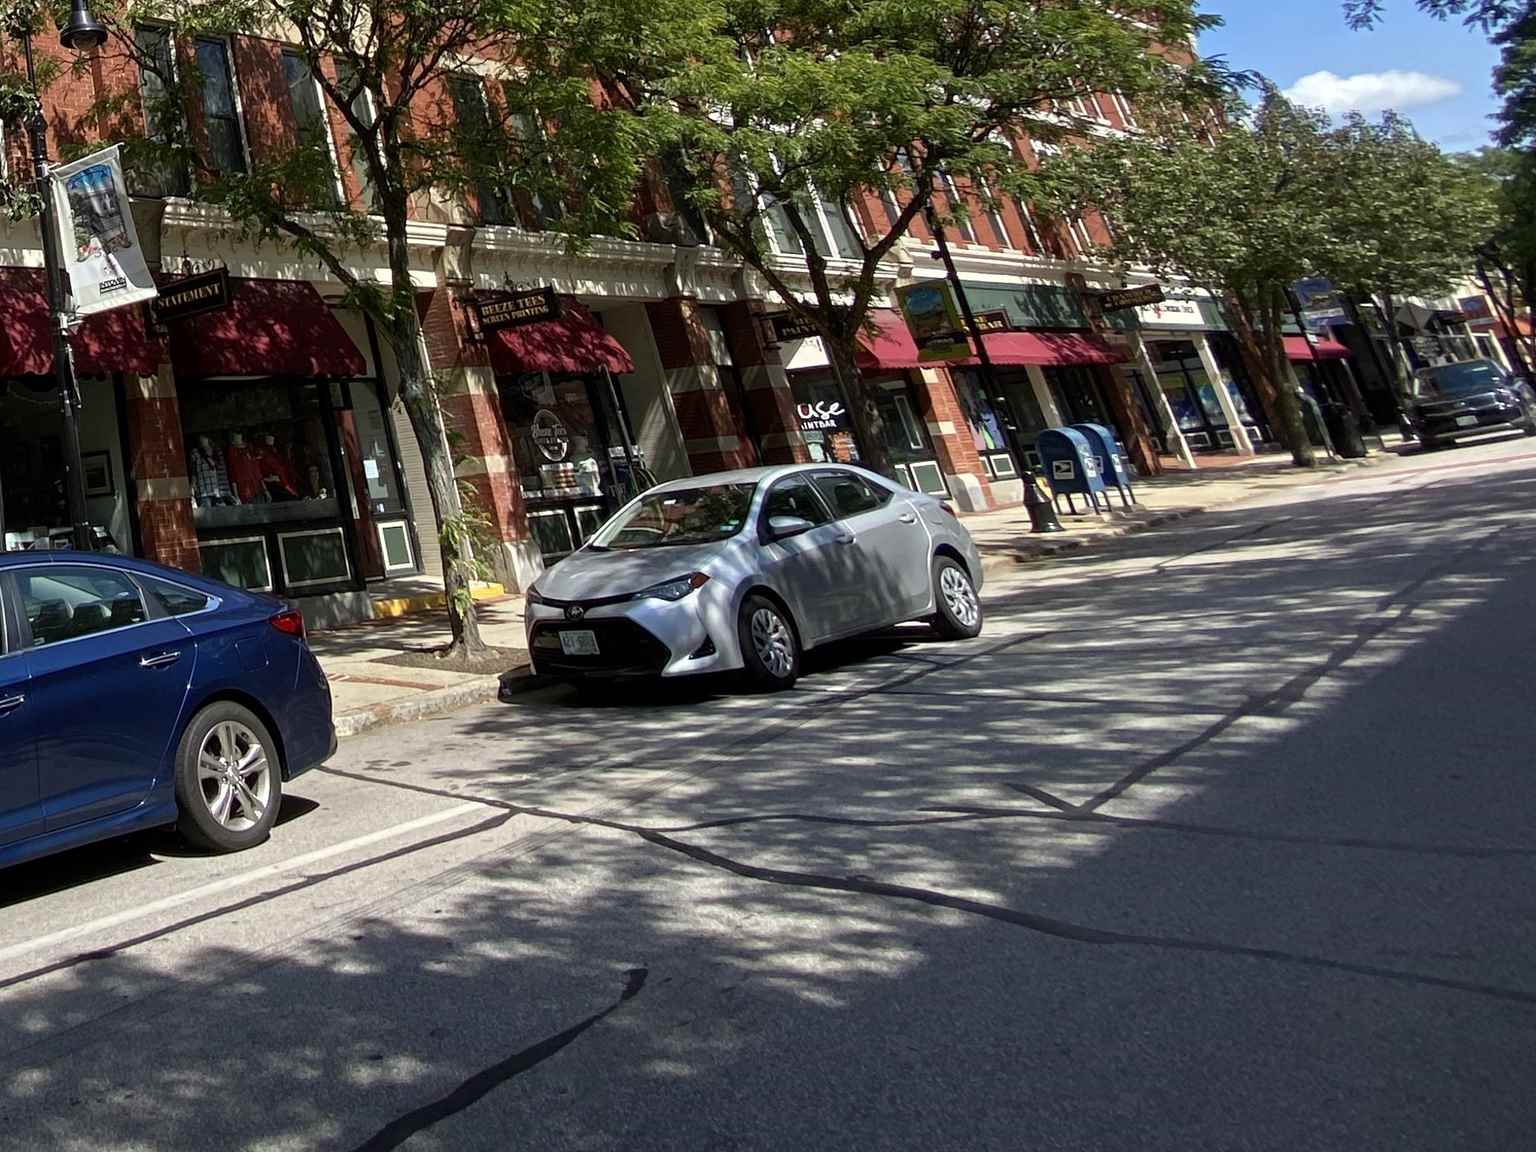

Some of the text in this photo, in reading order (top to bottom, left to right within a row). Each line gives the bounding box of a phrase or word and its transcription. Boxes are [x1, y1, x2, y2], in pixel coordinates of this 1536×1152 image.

[159, 282, 221, 307] STATEMENT
[481, 295, 546, 316] BEEZE TEES
[797, 400, 846, 420] use
[801, 418, 838, 430] INTBAR
